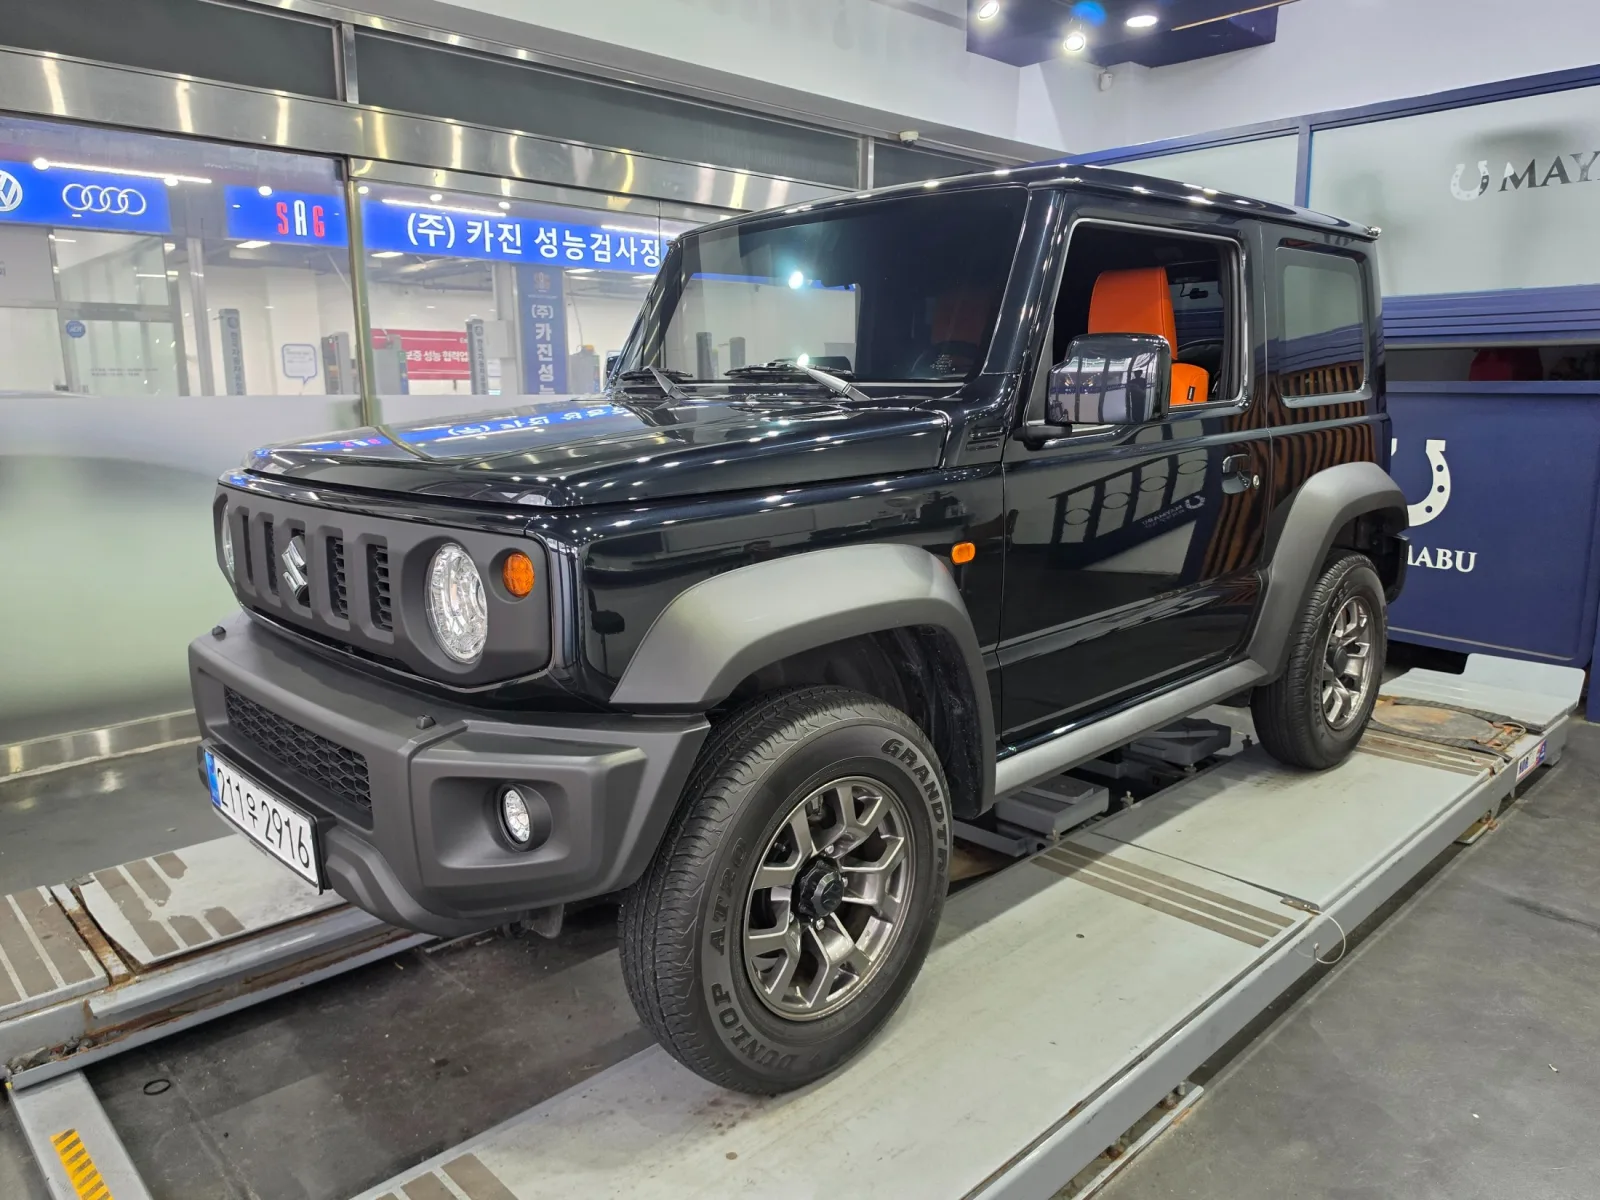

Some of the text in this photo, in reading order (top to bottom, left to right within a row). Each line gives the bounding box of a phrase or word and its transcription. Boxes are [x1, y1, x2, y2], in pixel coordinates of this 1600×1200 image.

[1497, 151, 1600, 193] MAY
[275, 199, 325, 238] SAG
[407, 212, 661, 269] (주) 카진 성능검사장
[531, 304, 554, 319] (주)
[710, 837, 799, 1071] DUNLOP AT20
